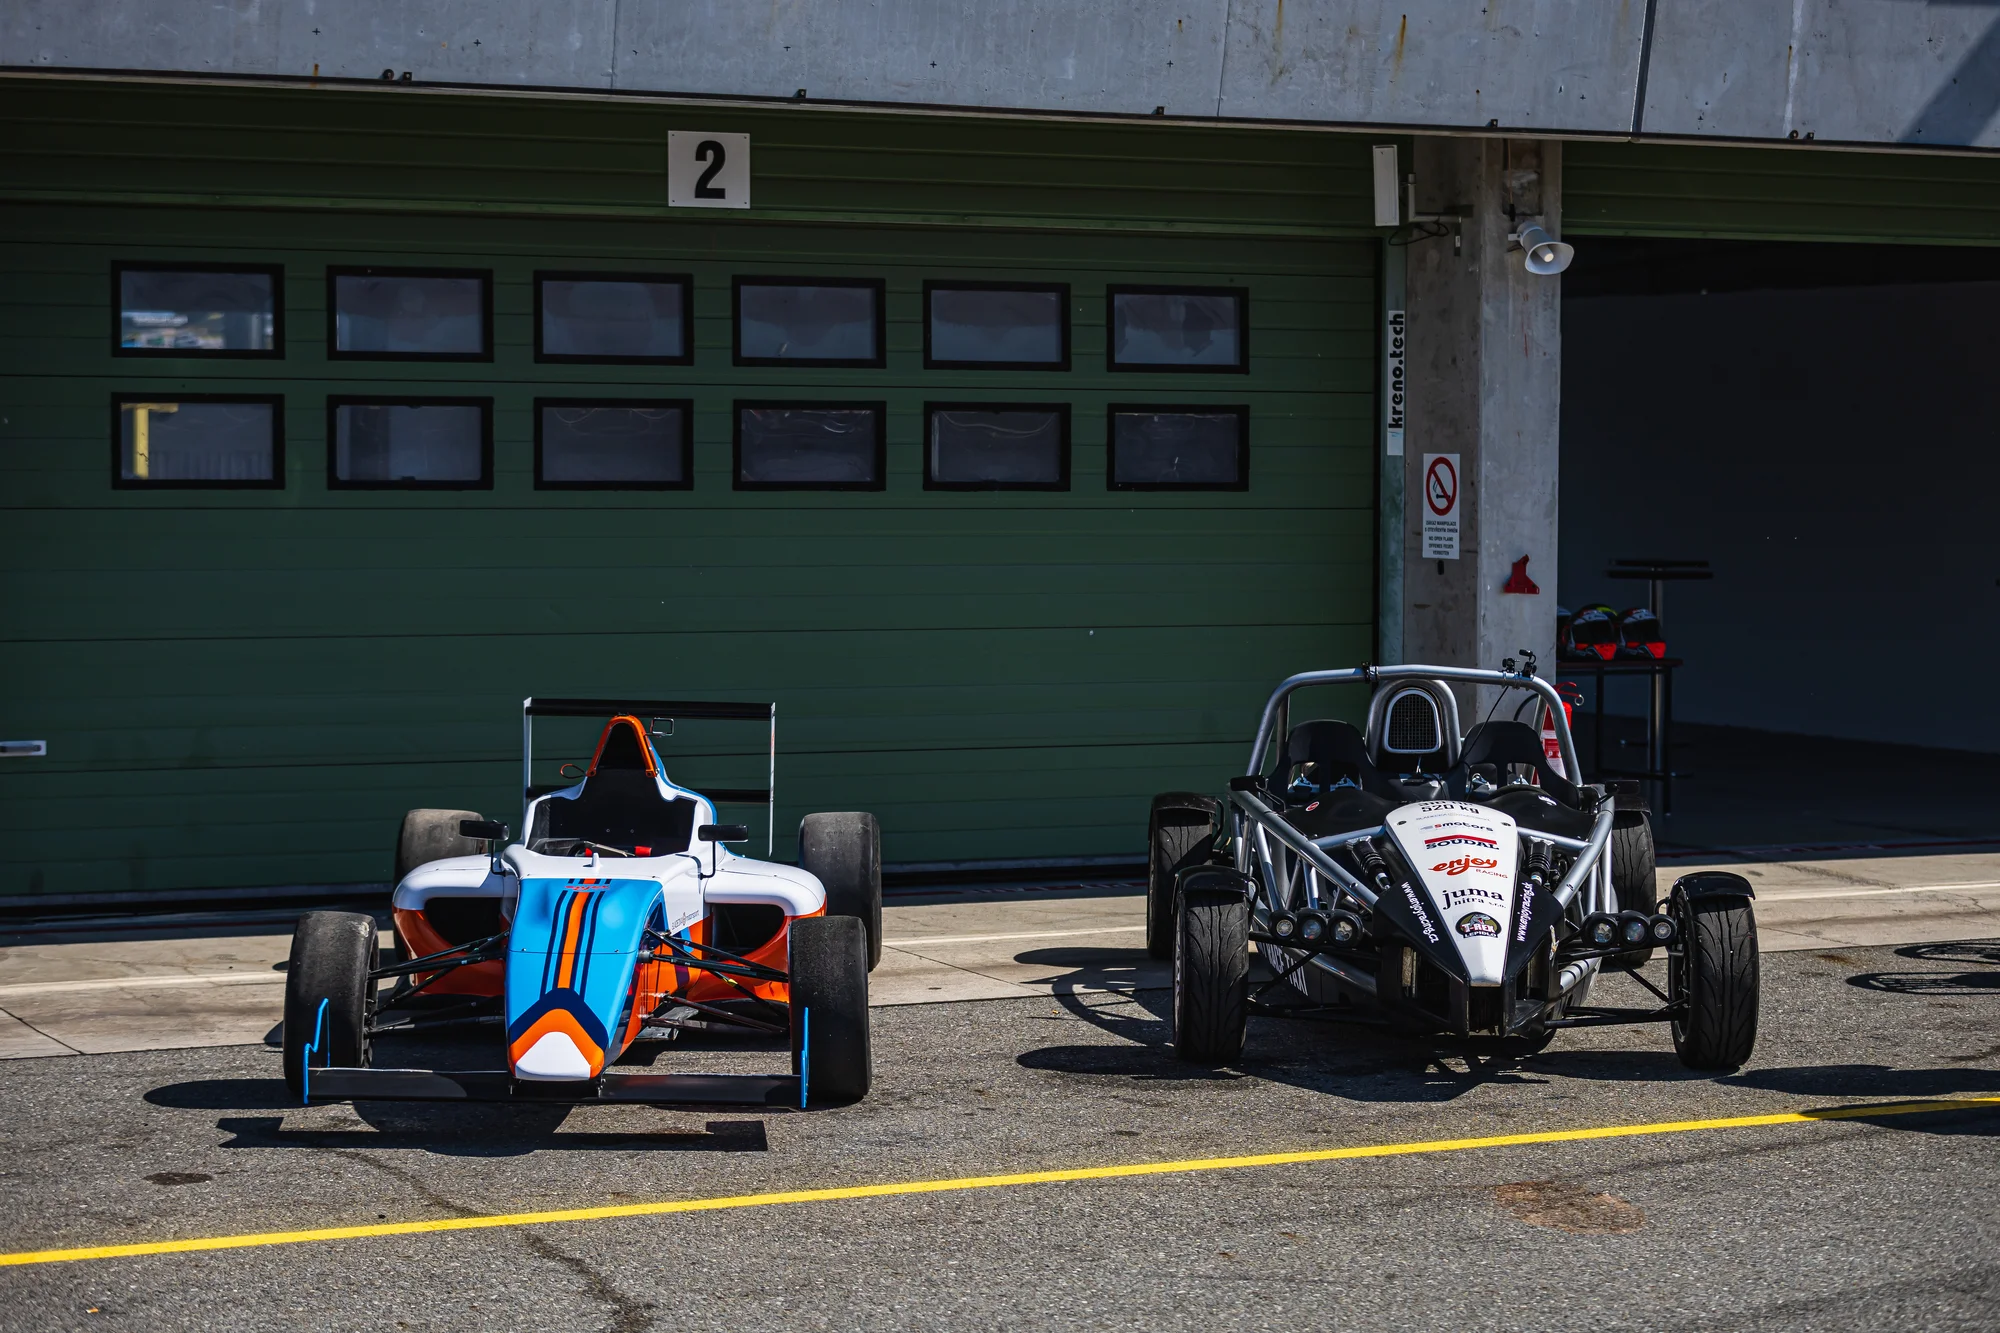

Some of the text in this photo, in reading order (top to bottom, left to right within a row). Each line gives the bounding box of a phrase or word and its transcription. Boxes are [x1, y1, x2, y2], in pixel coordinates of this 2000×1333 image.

[694, 140, 726, 199] 2
[1388, 313, 1404, 429] kreno.tech
[1421, 803, 1480, 815] 520 kg
[1426, 839, 1500, 850] SOUDAL
[1428, 854, 1498, 876] enjoy
[1475, 868, 1509, 879] RACING
[1442, 888, 1505, 910] juma
[1454, 897, 1485, 906] nitra
[1401, 881, 1440, 944] www.enjoyracing.cz
[1461, 922, 1496, 933] T-REX
